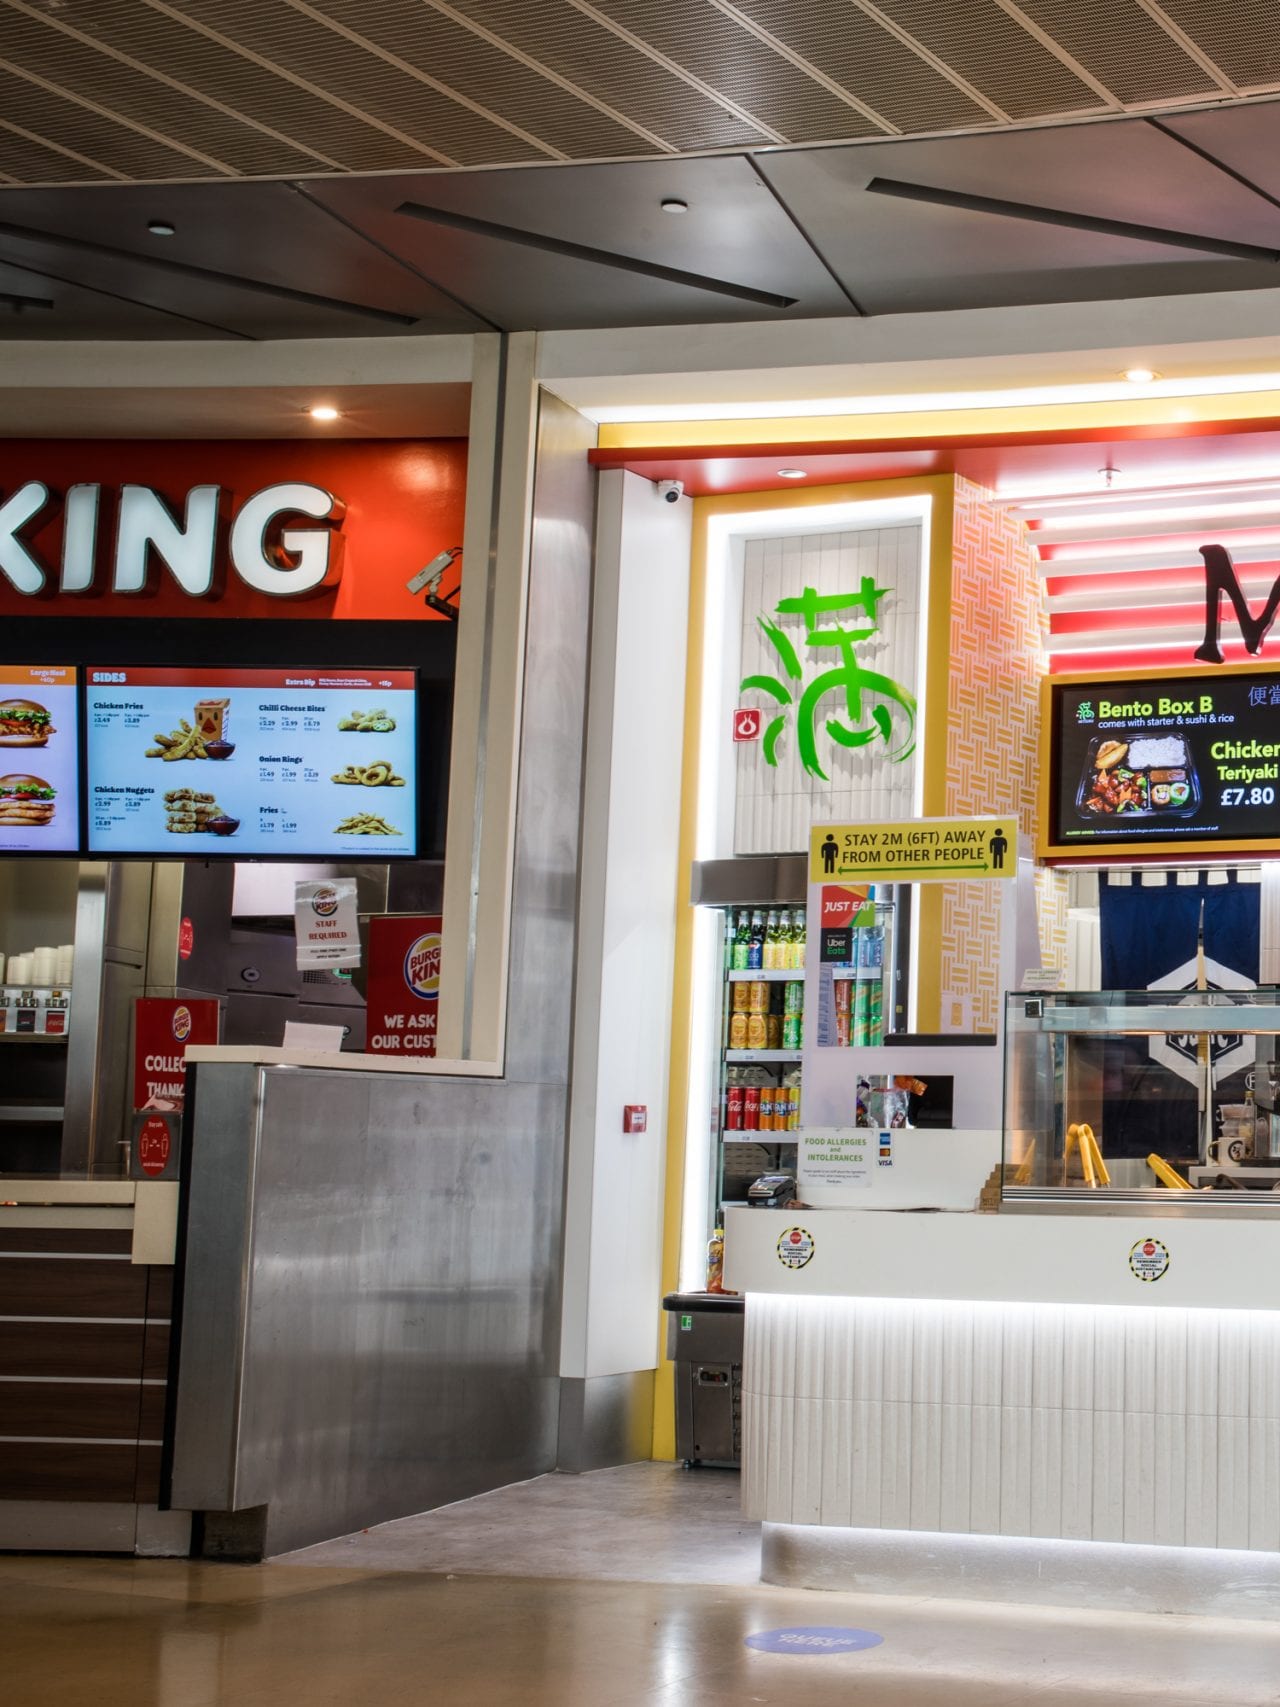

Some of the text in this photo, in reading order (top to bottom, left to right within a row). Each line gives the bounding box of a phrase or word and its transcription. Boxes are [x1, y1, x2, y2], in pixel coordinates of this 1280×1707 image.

[92, 672, 127, 683] SIDES
[93, 702, 144, 710] Chicken Fries
[258, 704, 279, 712] Chilli
[1098, 696, 1213, 719] Bento Box B
[1098, 713, 1235, 729] comes with starter & sushi & rice
[282, 756, 303, 764] Rings
[1217, 764, 1279, 784] Teriyaki
[125, 787, 155, 795] Nuggets
[1220, 787, 1275, 806] £7.80
[844, 830, 987, 848] STAY 2M (6FT) AWAY
[842, 847, 985, 864] FROM OTHER PEOPLE
[824, 901, 873, 914] JUST EAT
[315, 920, 338, 928] STAFF
[308, 931, 347, 940] REQUIRED
[826, 938, 847, 949] Uber
[826, 947, 847, 955] Eats
[410, 948, 441, 969] BURG
[411, 959, 441, 987] KIN
[384, 1014, 436, 1029] WE ASK
[371, 1034, 437, 1049] OUR CUST
[145, 1055, 186, 1072] COLLEC
[804, 1137, 867, 1146] FOOD ALLERGIES
[807, 1154, 864, 1162] INTOLERANCES
